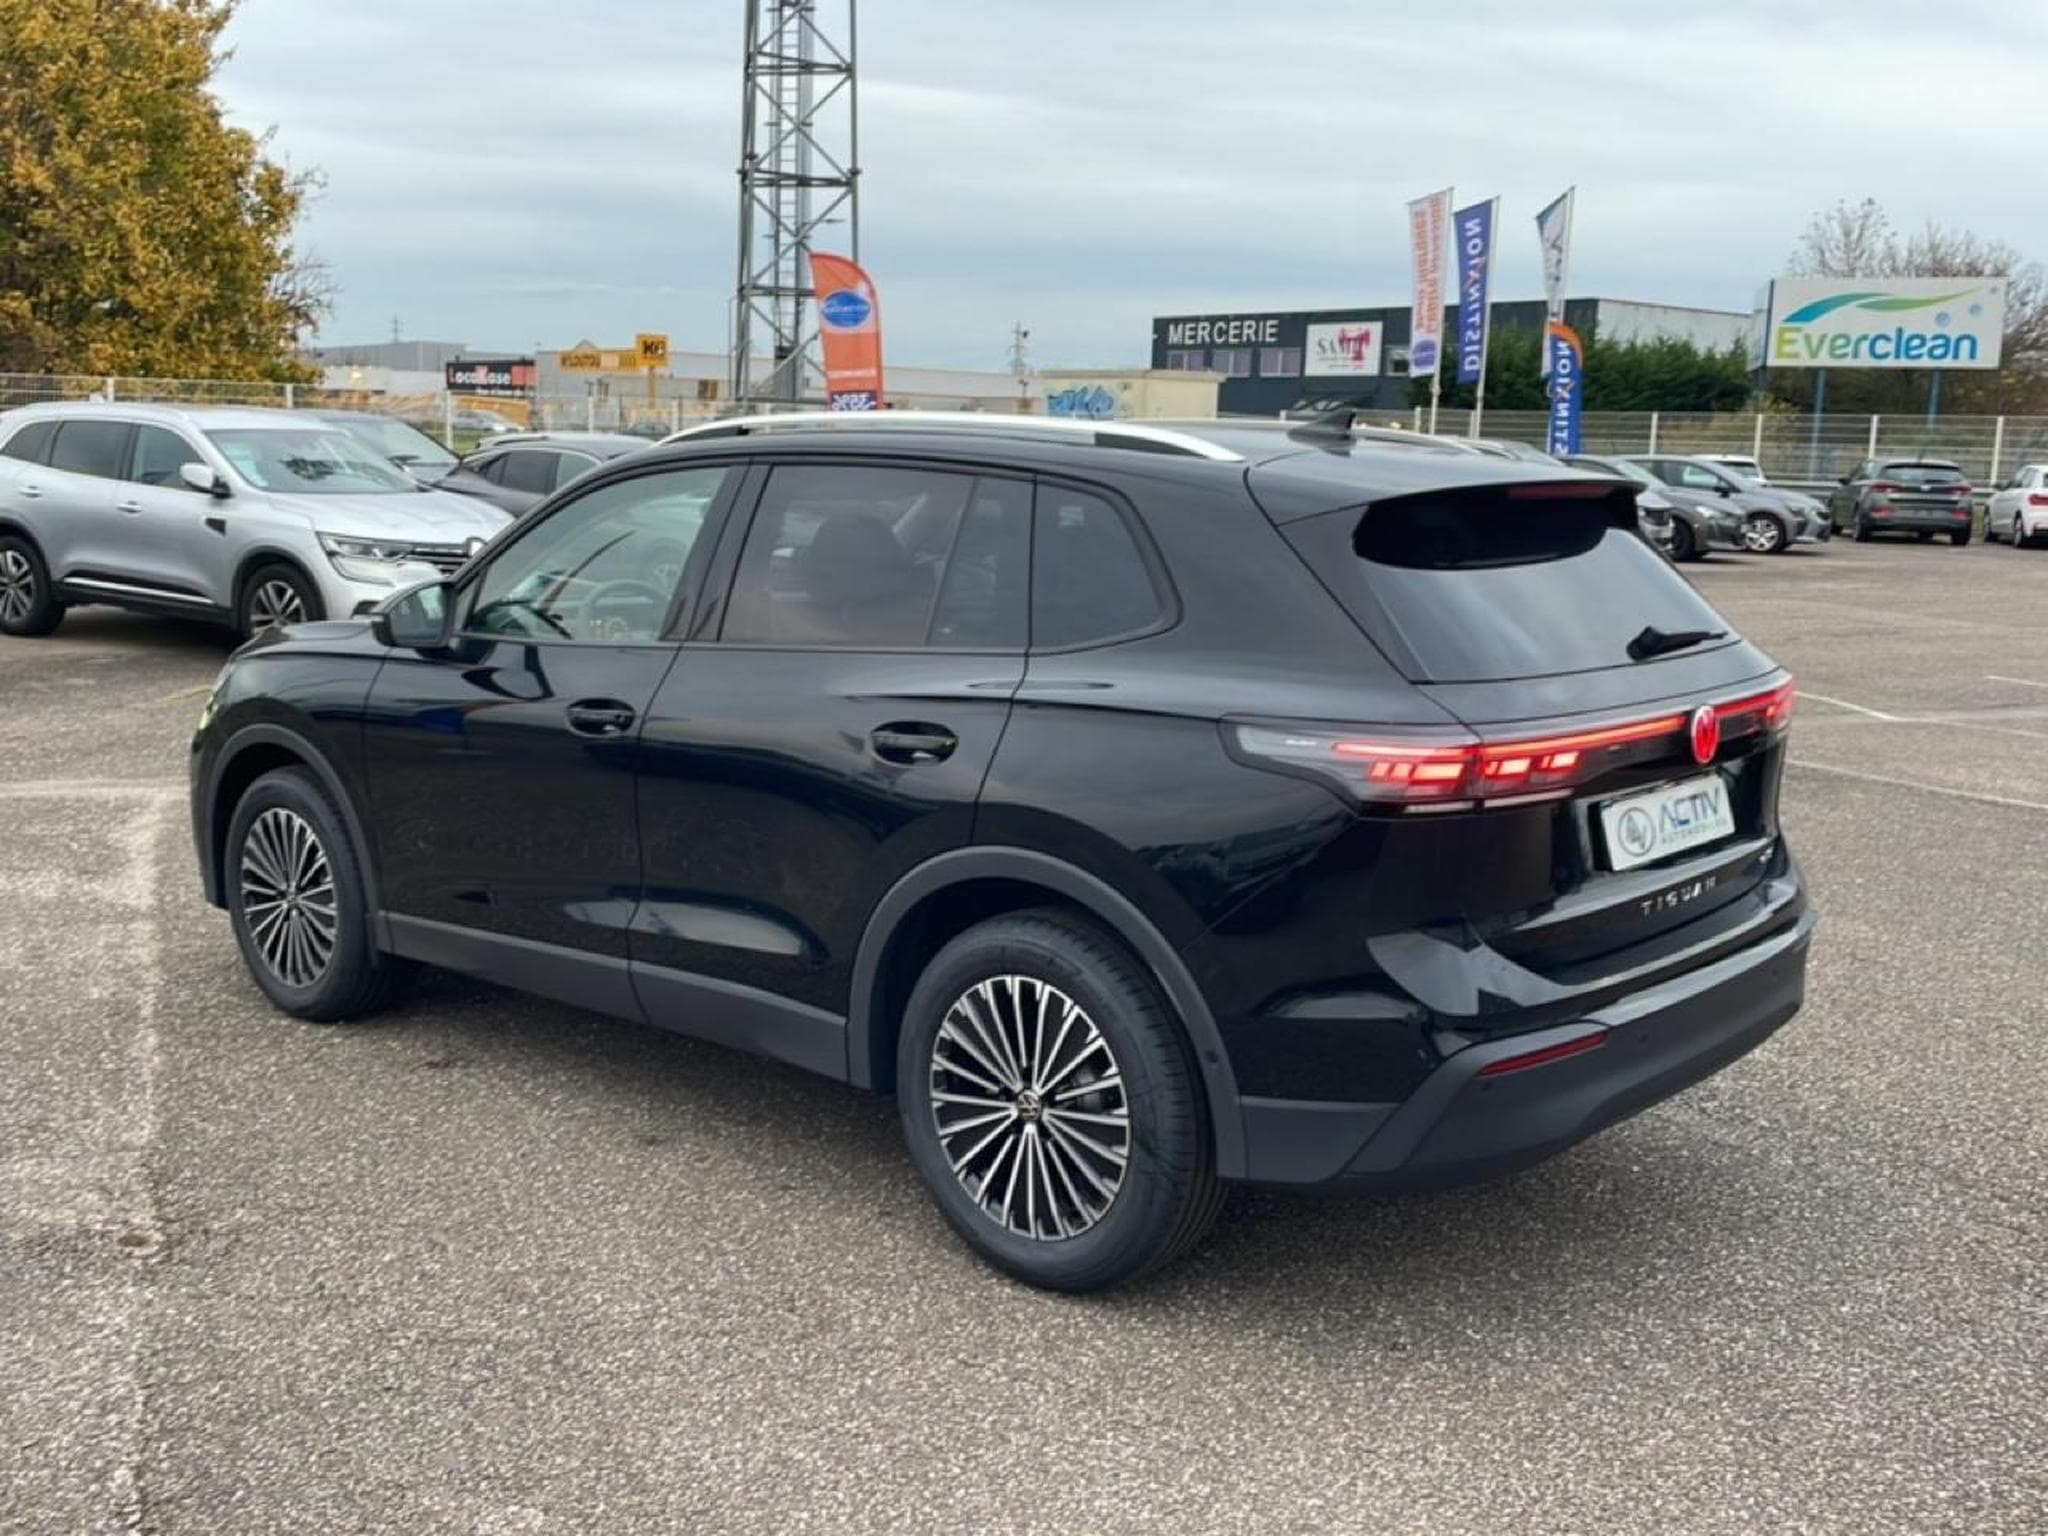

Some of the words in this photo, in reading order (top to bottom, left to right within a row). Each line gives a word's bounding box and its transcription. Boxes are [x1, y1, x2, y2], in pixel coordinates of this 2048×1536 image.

[1168, 319, 1280, 345] MERCERIE
[1775, 326, 1978, 361] Everclean
[1659, 787, 1719, 832] ACTIV
